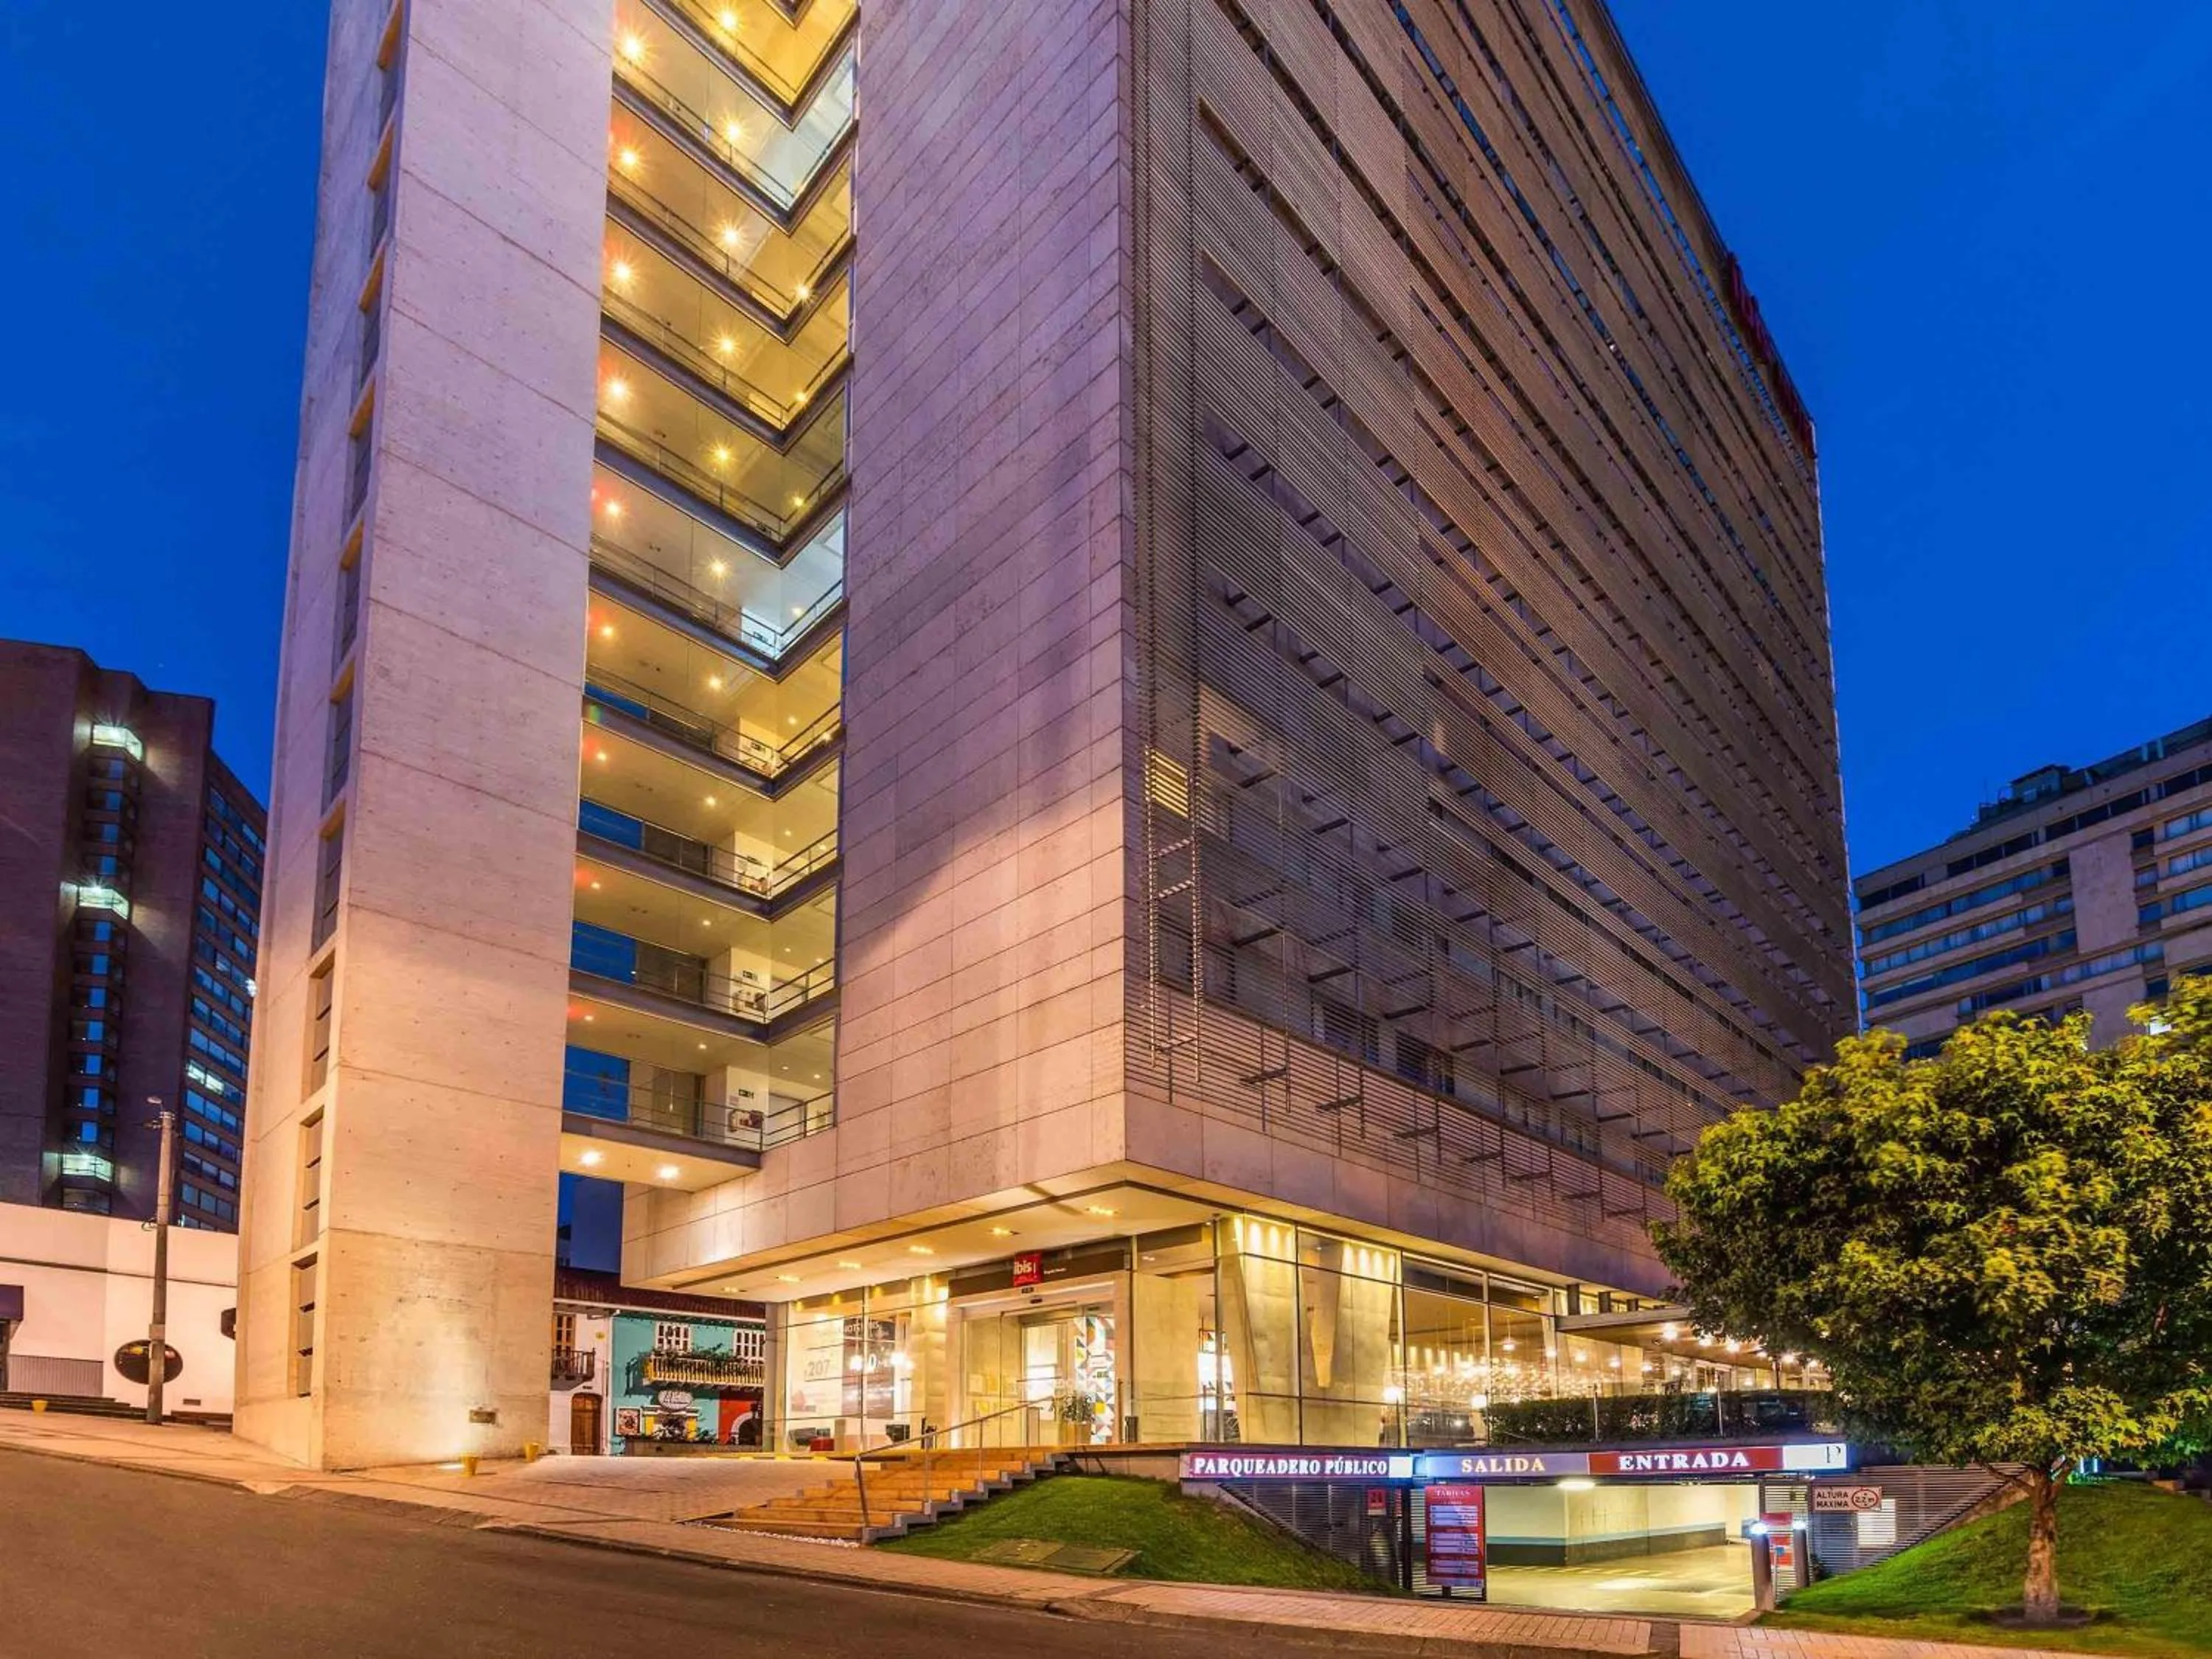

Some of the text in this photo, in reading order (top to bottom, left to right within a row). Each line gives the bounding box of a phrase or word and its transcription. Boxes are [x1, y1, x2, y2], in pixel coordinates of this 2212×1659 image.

[1194, 1457, 1388, 1476] PARQUEADERO PÚBLICO
[1461, 1458, 1545, 1472] SALIDA
[1619, 1451, 1750, 1470] ENTRADA
